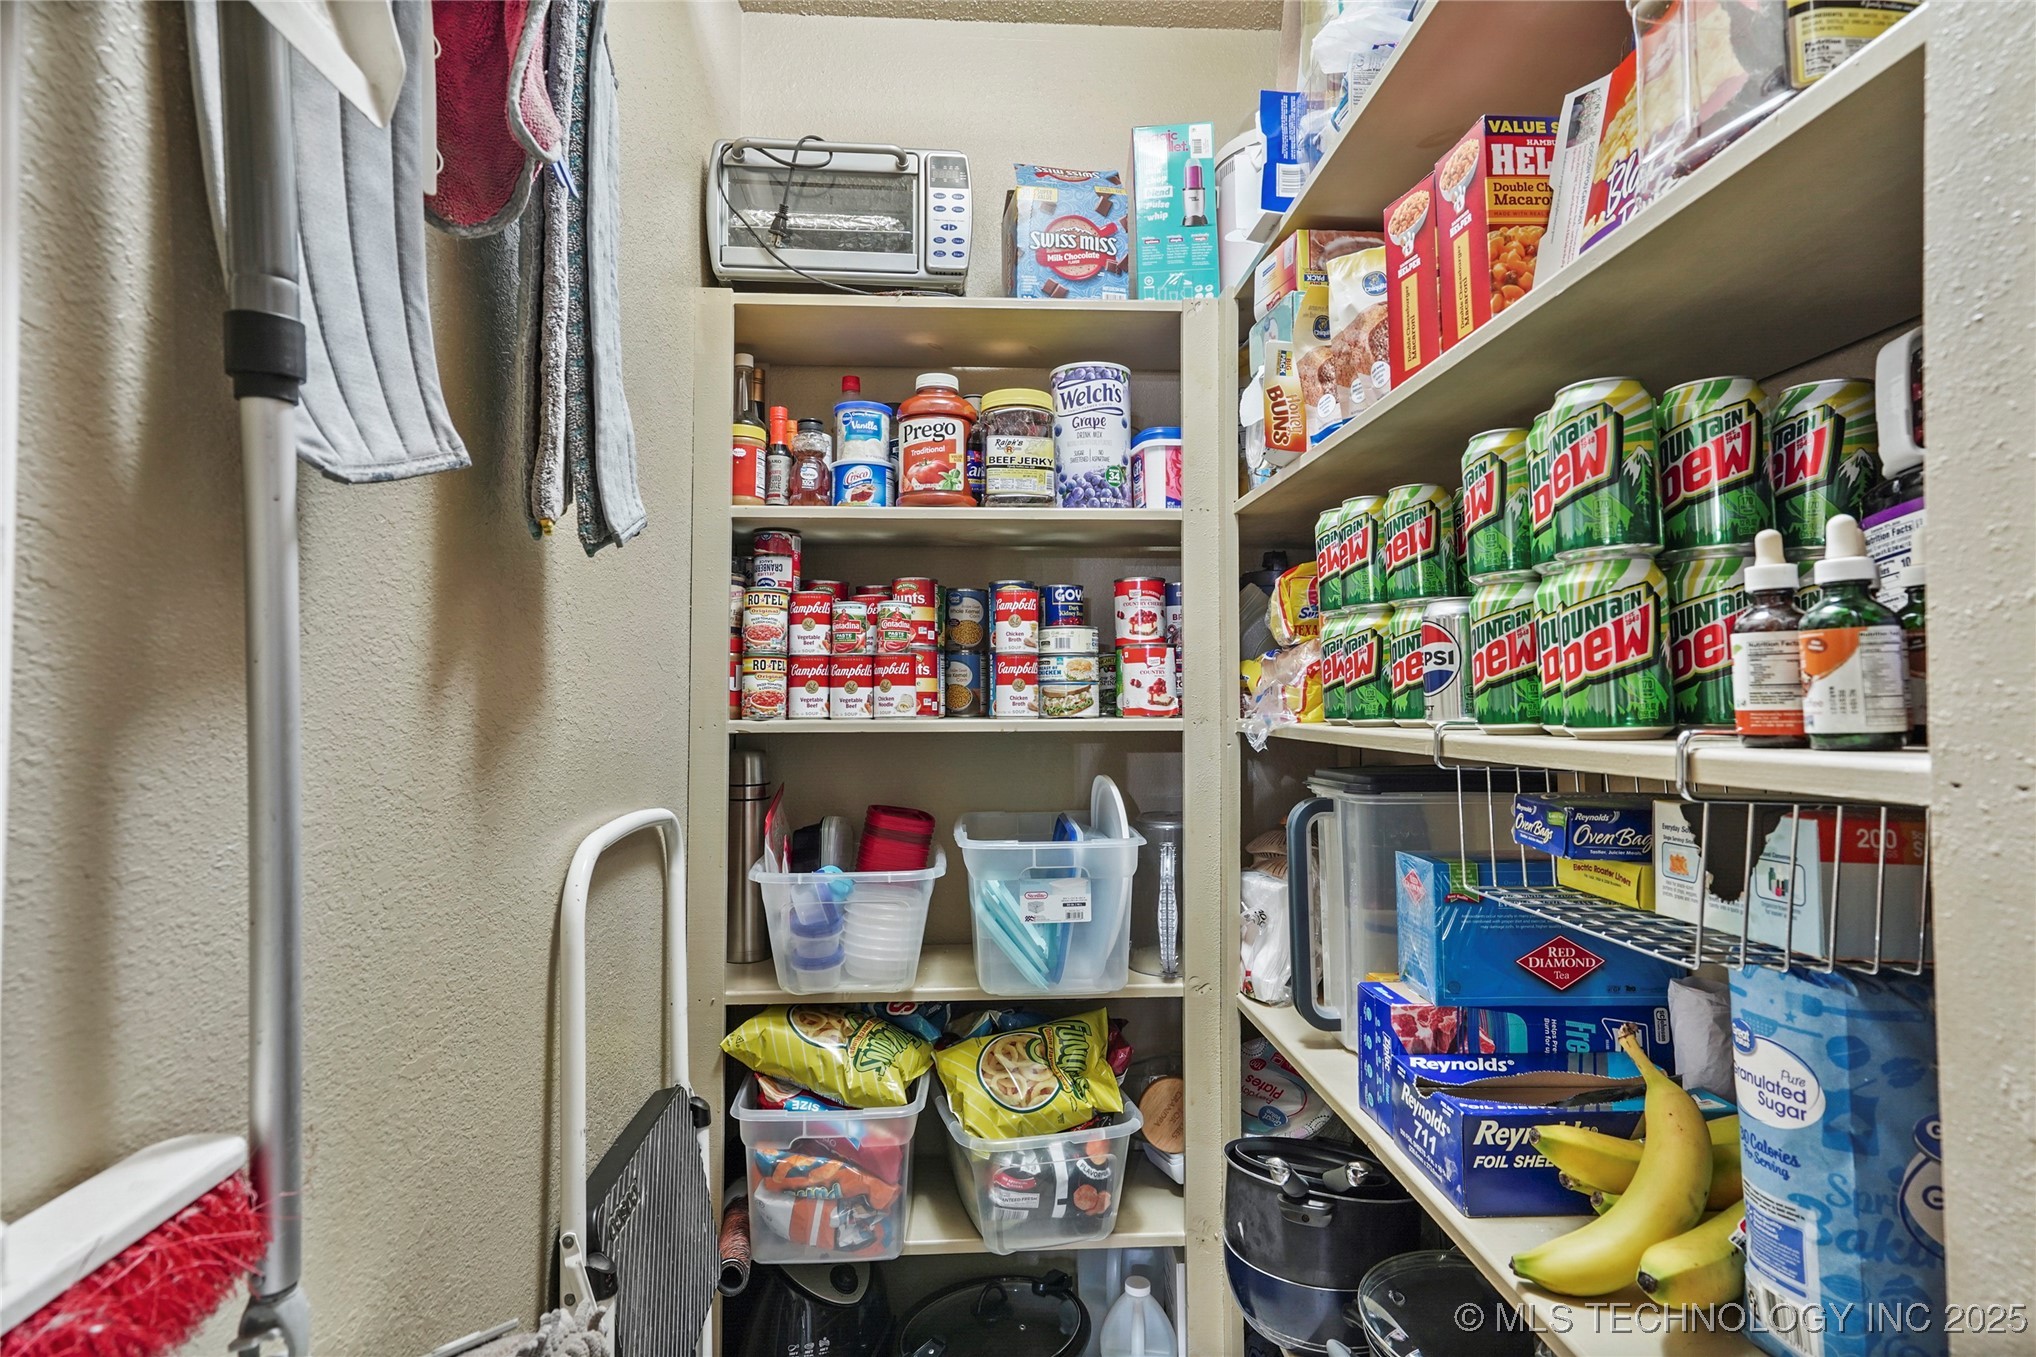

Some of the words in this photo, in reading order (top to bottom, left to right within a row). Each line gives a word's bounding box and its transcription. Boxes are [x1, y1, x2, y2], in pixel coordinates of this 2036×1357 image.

[1488, 120, 1548, 134] VALUE
[1491, 144, 1553, 176] HEL
[1493, 182, 1534, 192] Double
[1494, 194, 1553, 206] Macaro
[1146, 211, 1168, 222] whip
[1046, 254, 1064, 262] Milk
[1064, 252, 1100, 260] Chocolate
[1060, 384, 1122, 410] Welch's
[1266, 385, 1292, 446] BUNS
[1286, 394, 1303, 436] Honey
[851, 420, 878, 431] Vanilla
[1072, 416, 1107, 430] Grape
[904, 423, 956, 444] Prego
[994, 438, 1024, 447] Ralph's
[911, 445, 946, 456] Traditional
[988, 456, 1016, 464] BEEF
[1017, 456, 1054, 466] JERKY
[846, 470, 869, 484] Crisco
[1108, 472, 1120, 480] 34
[1892, 524, 1913, 537] Facts
[1625, 614, 1640, 626] 1948
[1294, 624, 1320, 636] TEXA
[1575, 812, 1610, 822] Reynolds
[1515, 812, 1533, 832] Oven
[1532, 820, 1554, 844] Bags
[1662, 822, 1680, 833] Everyday
[1573, 824, 1613, 846] Oven
[1616, 827, 1653, 854] Bag
[1856, 828, 1898, 849] 200
[1572, 863, 1593, 873] Electric
[1594, 866, 1615, 878] Roaster
[1615, 872, 1632, 887] Liners
[1548, 946, 1576, 958] RED
[1528, 957, 1596, 968] DIAMOND
[1554, 971, 1570, 980] Tea
[1732, 1023, 1750, 1040] Great
[1410, 1056, 1510, 1073] Reynolds
[1780, 1070, 1806, 1088] Pure
[1245, 1074, 1285, 1100] Plates
[792, 1100, 820, 1112] SIZE
[1400, 1082, 1448, 1138] Reynolds
[1758, 1092, 1807, 1122] Sugar
[1413, 1120, 1437, 1155] 711
[1750, 1135, 1801, 1168] Calories
[1473, 1156, 1509, 1169] FOIL
[1514, 1155, 1554, 1168] SHEE
[1754, 1152, 1790, 1181] Serving
